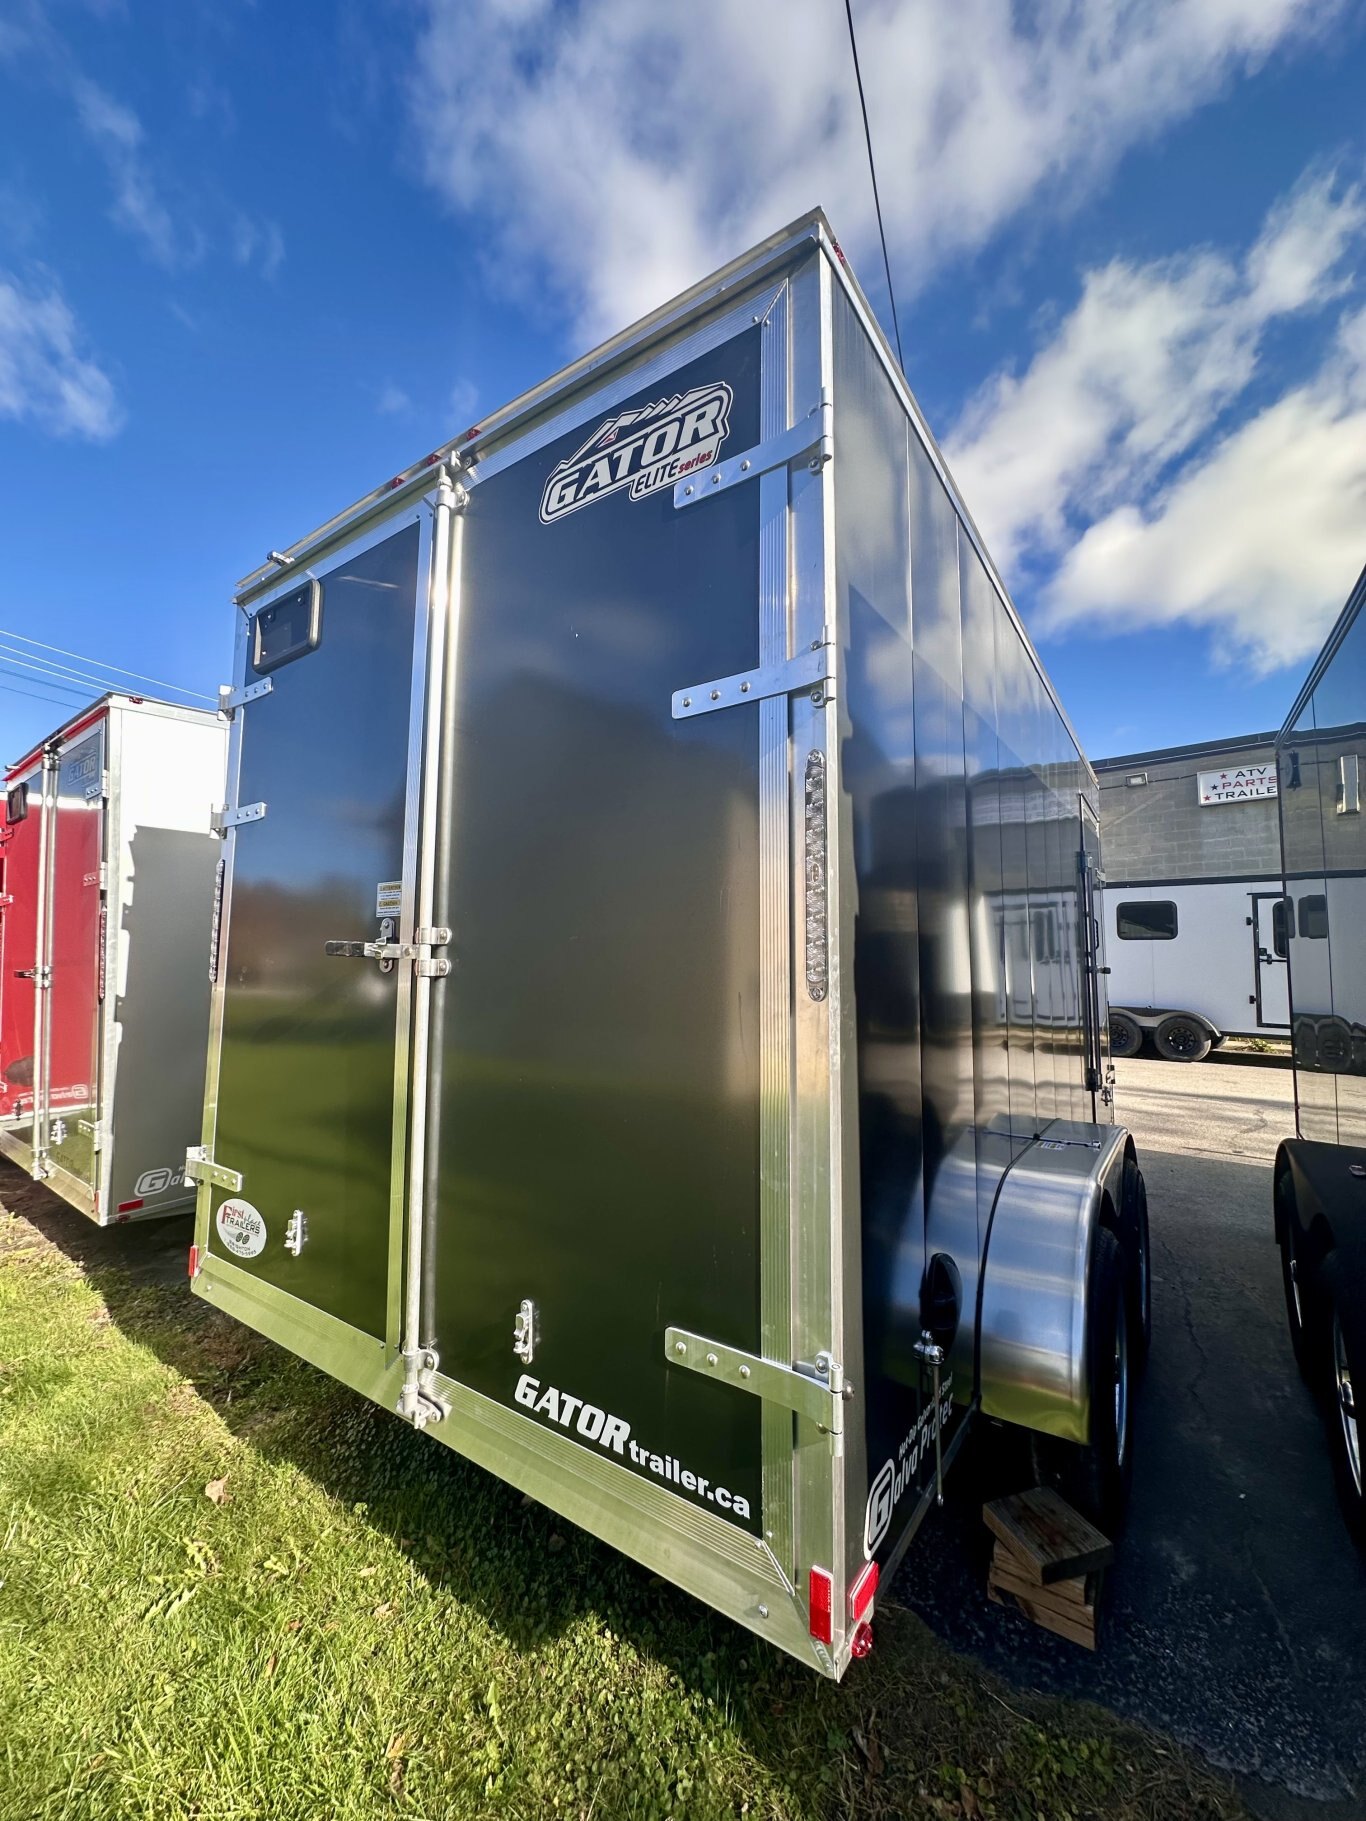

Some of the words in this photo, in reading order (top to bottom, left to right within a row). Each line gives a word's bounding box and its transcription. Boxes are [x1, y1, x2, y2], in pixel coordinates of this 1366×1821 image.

[548, 399, 721, 513] GATOR
[1235, 767, 1267, 779] ATV
[1221, 776, 1277, 790] PARTS
[226, 1215, 261, 1234] TRAILERS
